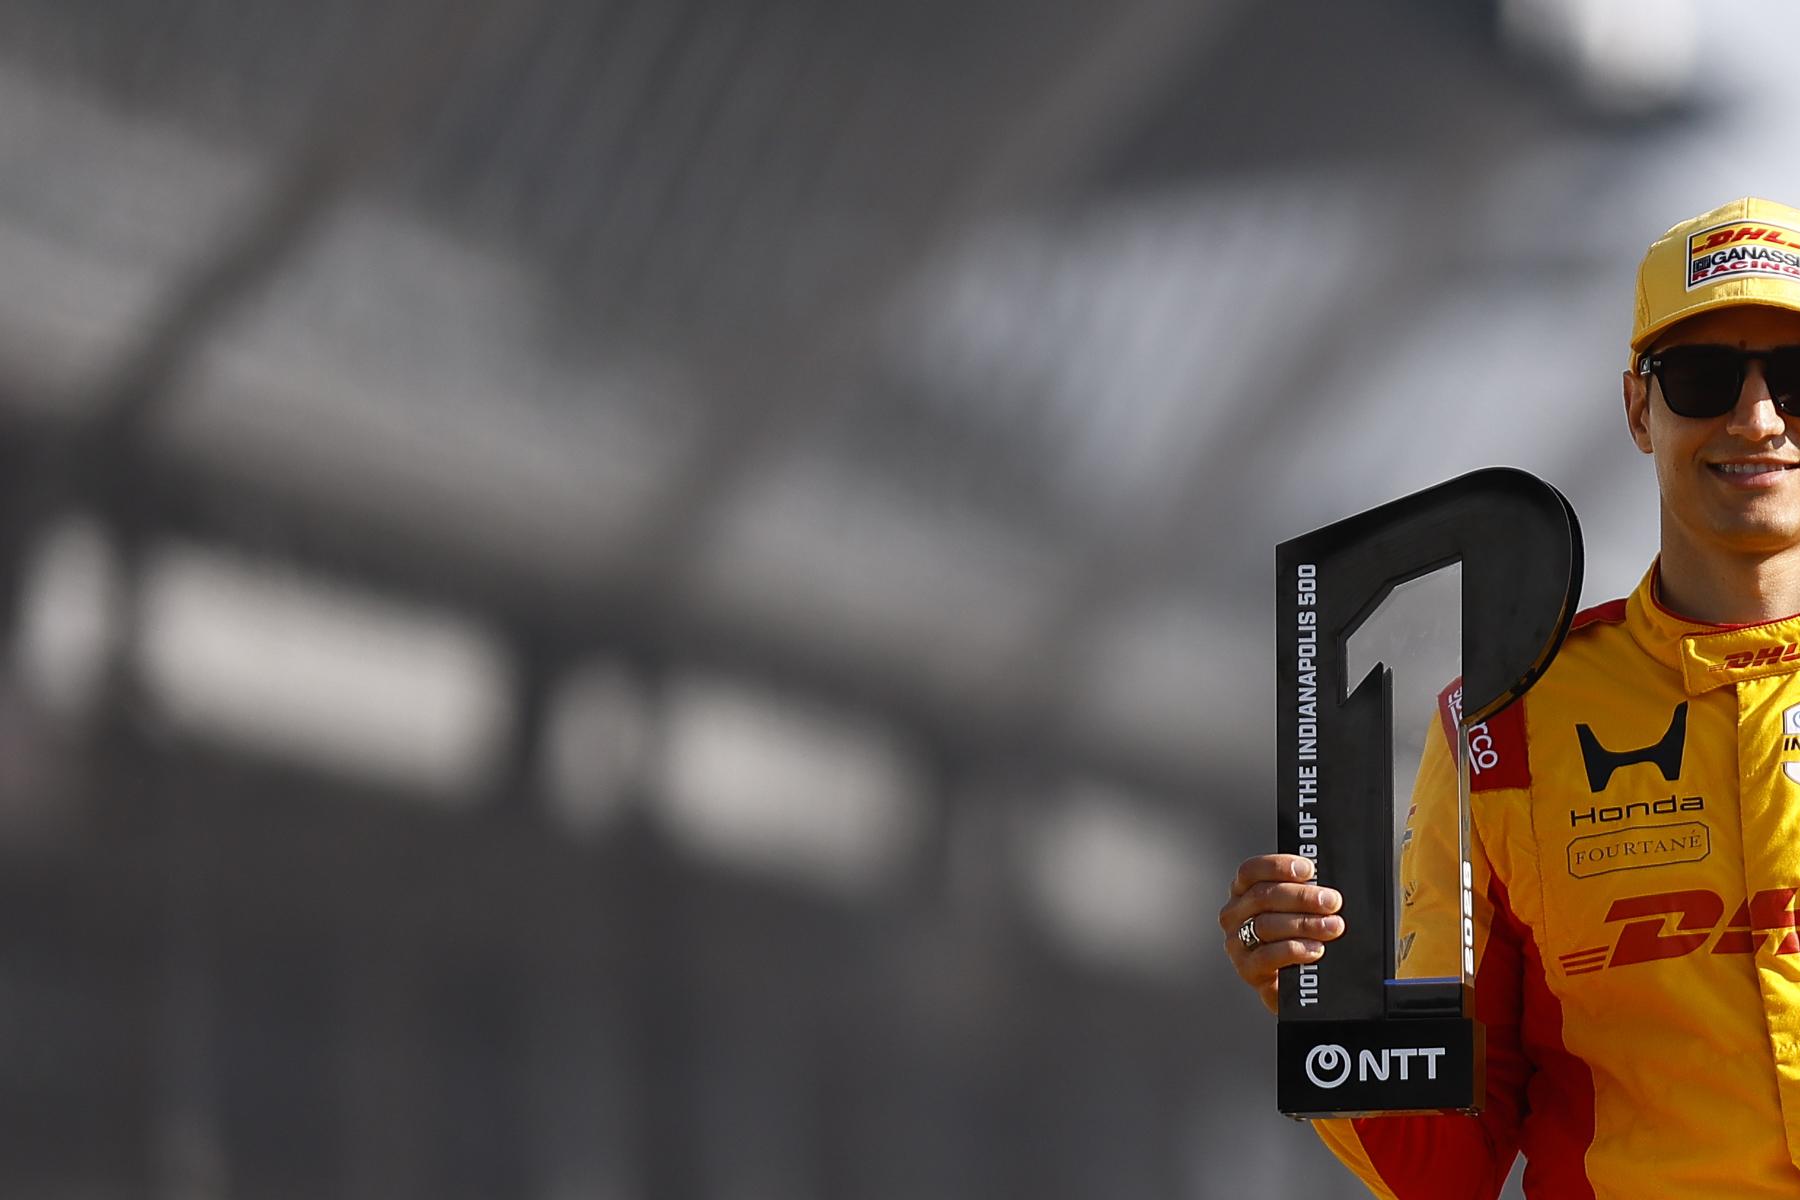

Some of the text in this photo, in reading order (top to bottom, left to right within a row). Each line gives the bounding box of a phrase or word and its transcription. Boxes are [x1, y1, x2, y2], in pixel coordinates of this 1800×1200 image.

[1704, 227, 1786, 249] DHL
[1692, 260, 1800, 281] RACING
[1711, 246, 1800, 267] GANASSI
[1298, 564, 1316, 605] 500
[1298, 611, 1317, 760] INDIANAPOLIS
[1299, 766, 1317, 807] THE
[1299, 811, 1317, 838] OF
[1570, 794, 1704, 827] Honda
[1575, 829, 1703, 864] FOURTANÉ
[1462, 860, 1474, 976] 2026
[1299, 962, 1318, 1007] 110T
[1359, 1048, 1446, 1081] NTT
